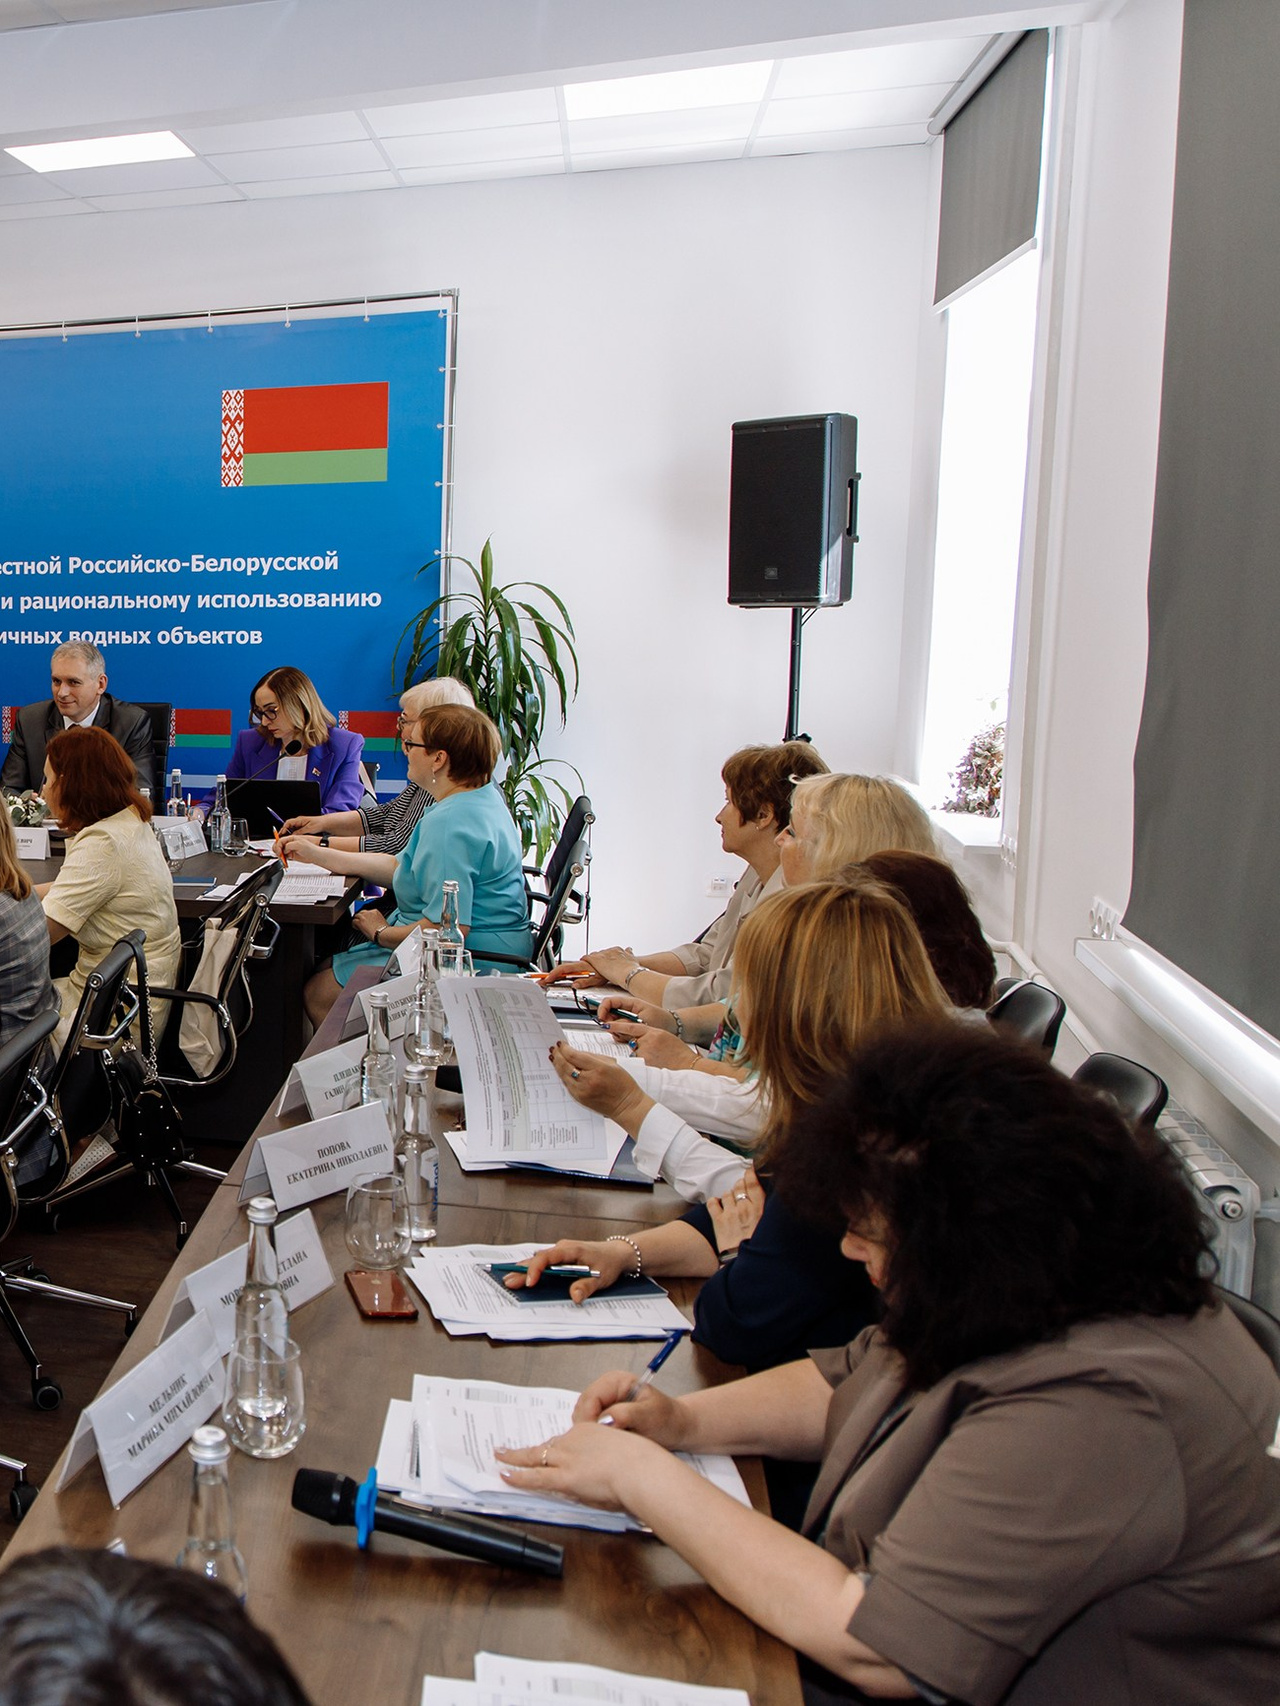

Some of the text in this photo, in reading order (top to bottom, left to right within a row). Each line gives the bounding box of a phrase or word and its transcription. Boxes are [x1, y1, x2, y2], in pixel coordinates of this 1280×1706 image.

[68, 550, 339, 576] Российско-Белорусской
[1, 596, 13, 610] и
[20, 594, 191, 614] рациональному
[197, 592, 382, 609] использованию
[69, 630, 151, 647] водных
[156, 626, 263, 645] объектов
[317, 1140, 352, 1159] ПОПОВА
[286, 1143, 389, 1185] ЕКАТЕРИНА НИКОЛАЕВНА
[148, 1373, 188, 1416] МЕЛЬНИК
[127, 1372, 215, 1460] МАРИНА МИХАЙЛОВНА
